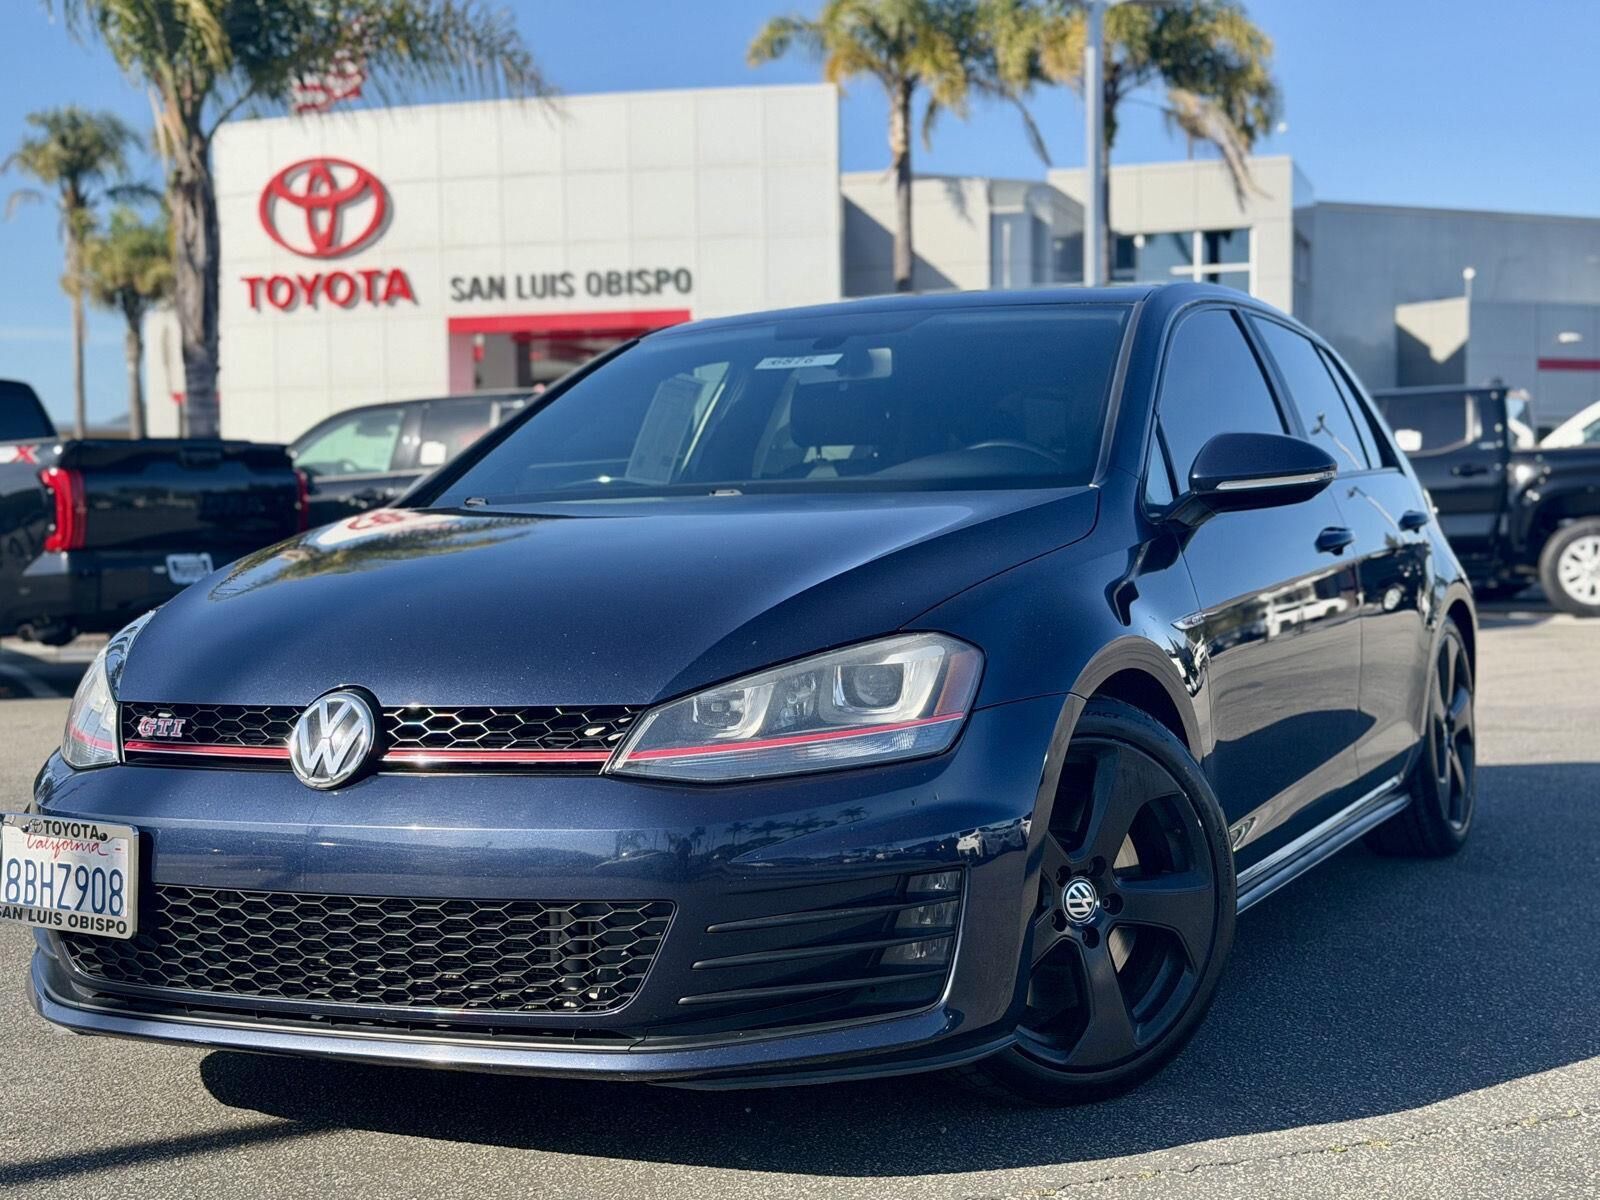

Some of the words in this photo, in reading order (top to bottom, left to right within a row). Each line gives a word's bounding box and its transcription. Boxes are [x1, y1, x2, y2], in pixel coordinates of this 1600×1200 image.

[239, 268, 418, 312] TOYOTA
[450, 275, 506, 303] SAN
[516, 272, 575, 299] LUIS
[585, 267, 692, 298] OBISPO
[137, 715, 185, 738] GTI
[43, 819, 99, 841] TOYOTA
[27, 834, 109, 859] California
[5, 858, 124, 917] 8BHZ908
[28, 908, 63, 926] LUIS
[67, 913, 128, 935] OBISPO
